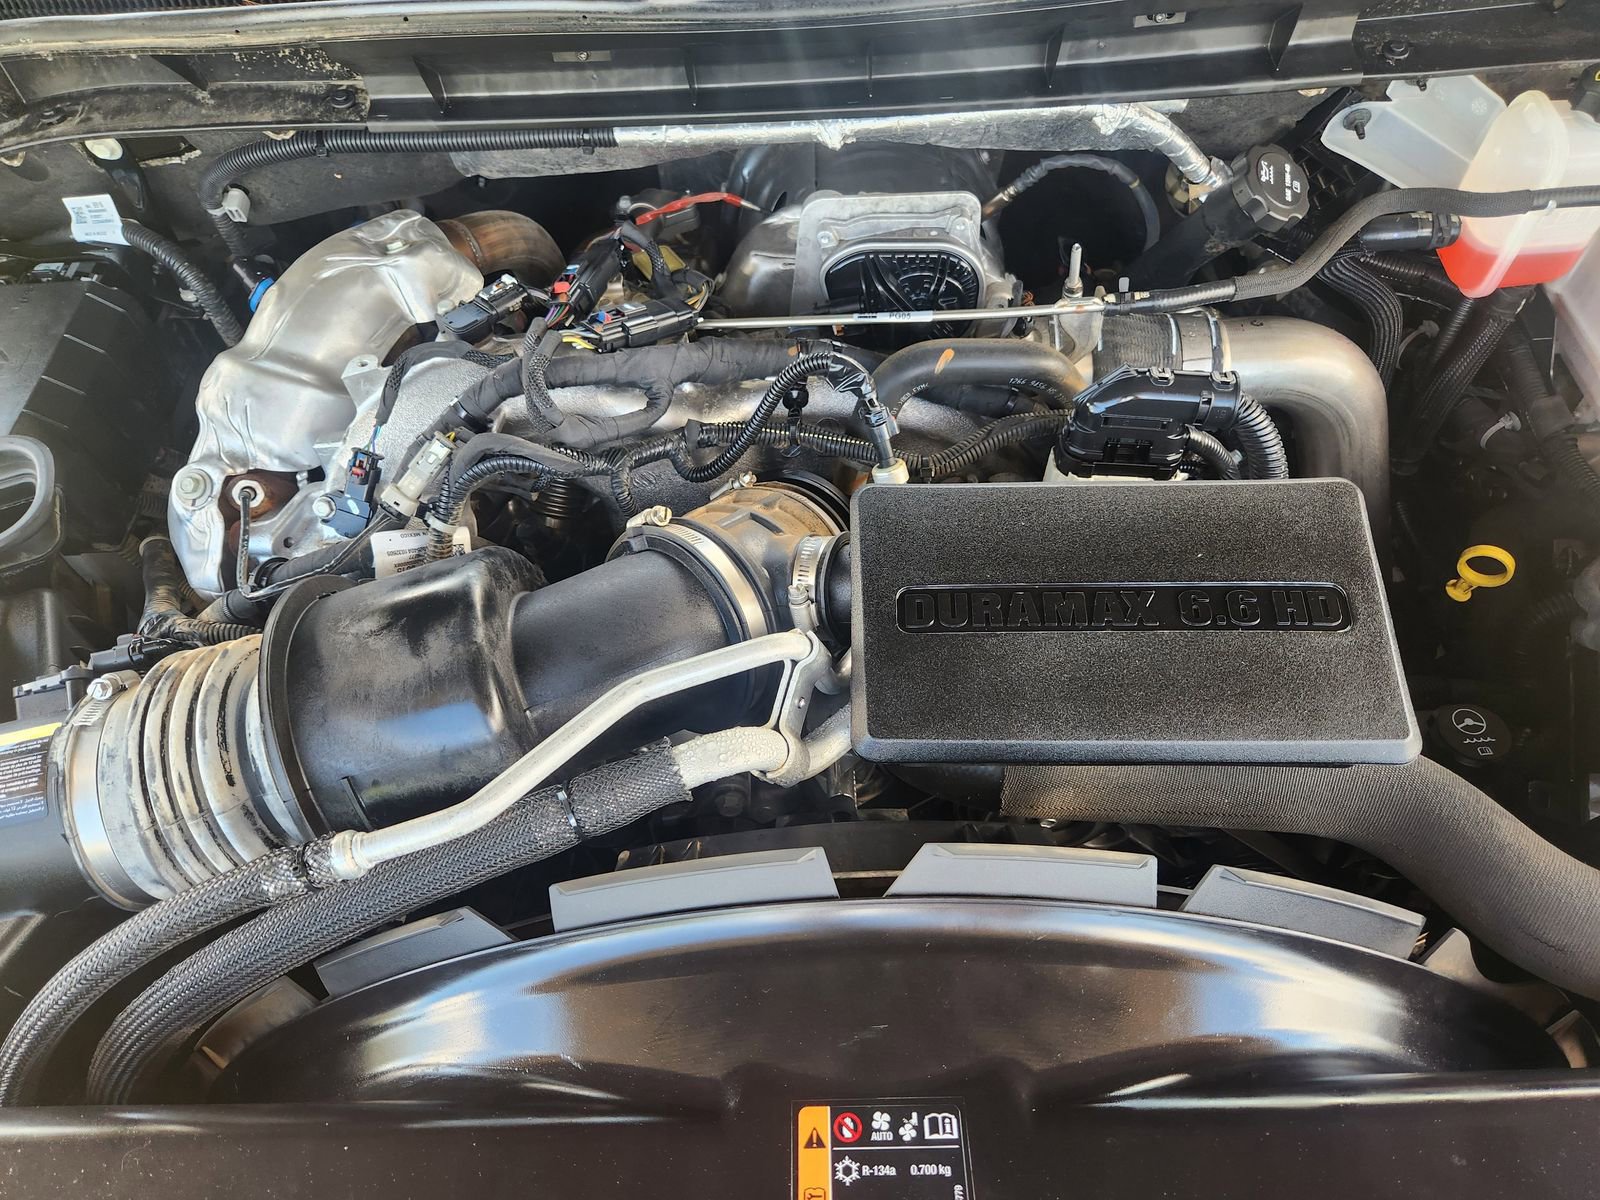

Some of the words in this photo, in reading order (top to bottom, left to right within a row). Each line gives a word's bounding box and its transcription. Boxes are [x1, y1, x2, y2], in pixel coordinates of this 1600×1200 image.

[904, 590, 1160, 628] DURAMAX
[1178, 590, 1261, 626] 6.6
[1272, 590, 1344, 626] HD
[870, 1131, 894, 1141] AUTO
[861, 1164, 897, 1177] R-134a
[909, 1163, 938, 1176] 0.700
[938, 1163, 952, 1177] kg
